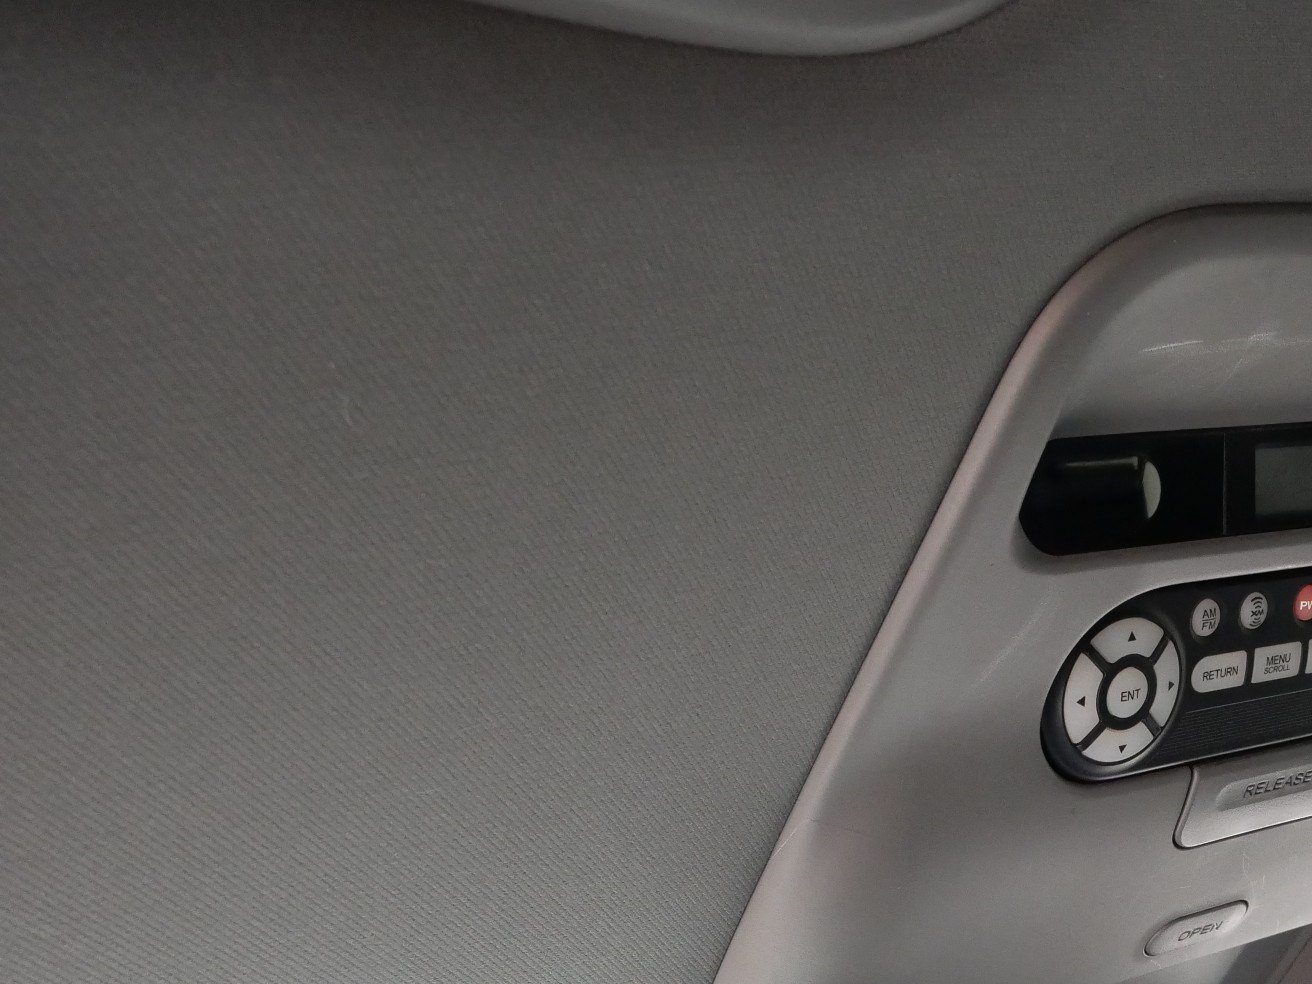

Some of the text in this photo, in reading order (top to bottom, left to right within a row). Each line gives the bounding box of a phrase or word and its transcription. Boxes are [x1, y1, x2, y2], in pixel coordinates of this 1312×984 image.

[1202, 608, 1217, 619] AM
[1201, 621, 1217, 631] FM
[1265, 653, 1292, 667] MENU
[1202, 666, 1239, 682] RETURN
[1263, 664, 1291, 675] SCROLL
[1120, 688, 1141, 702] ENT
[1177, 921, 1223, 942] OPEN
